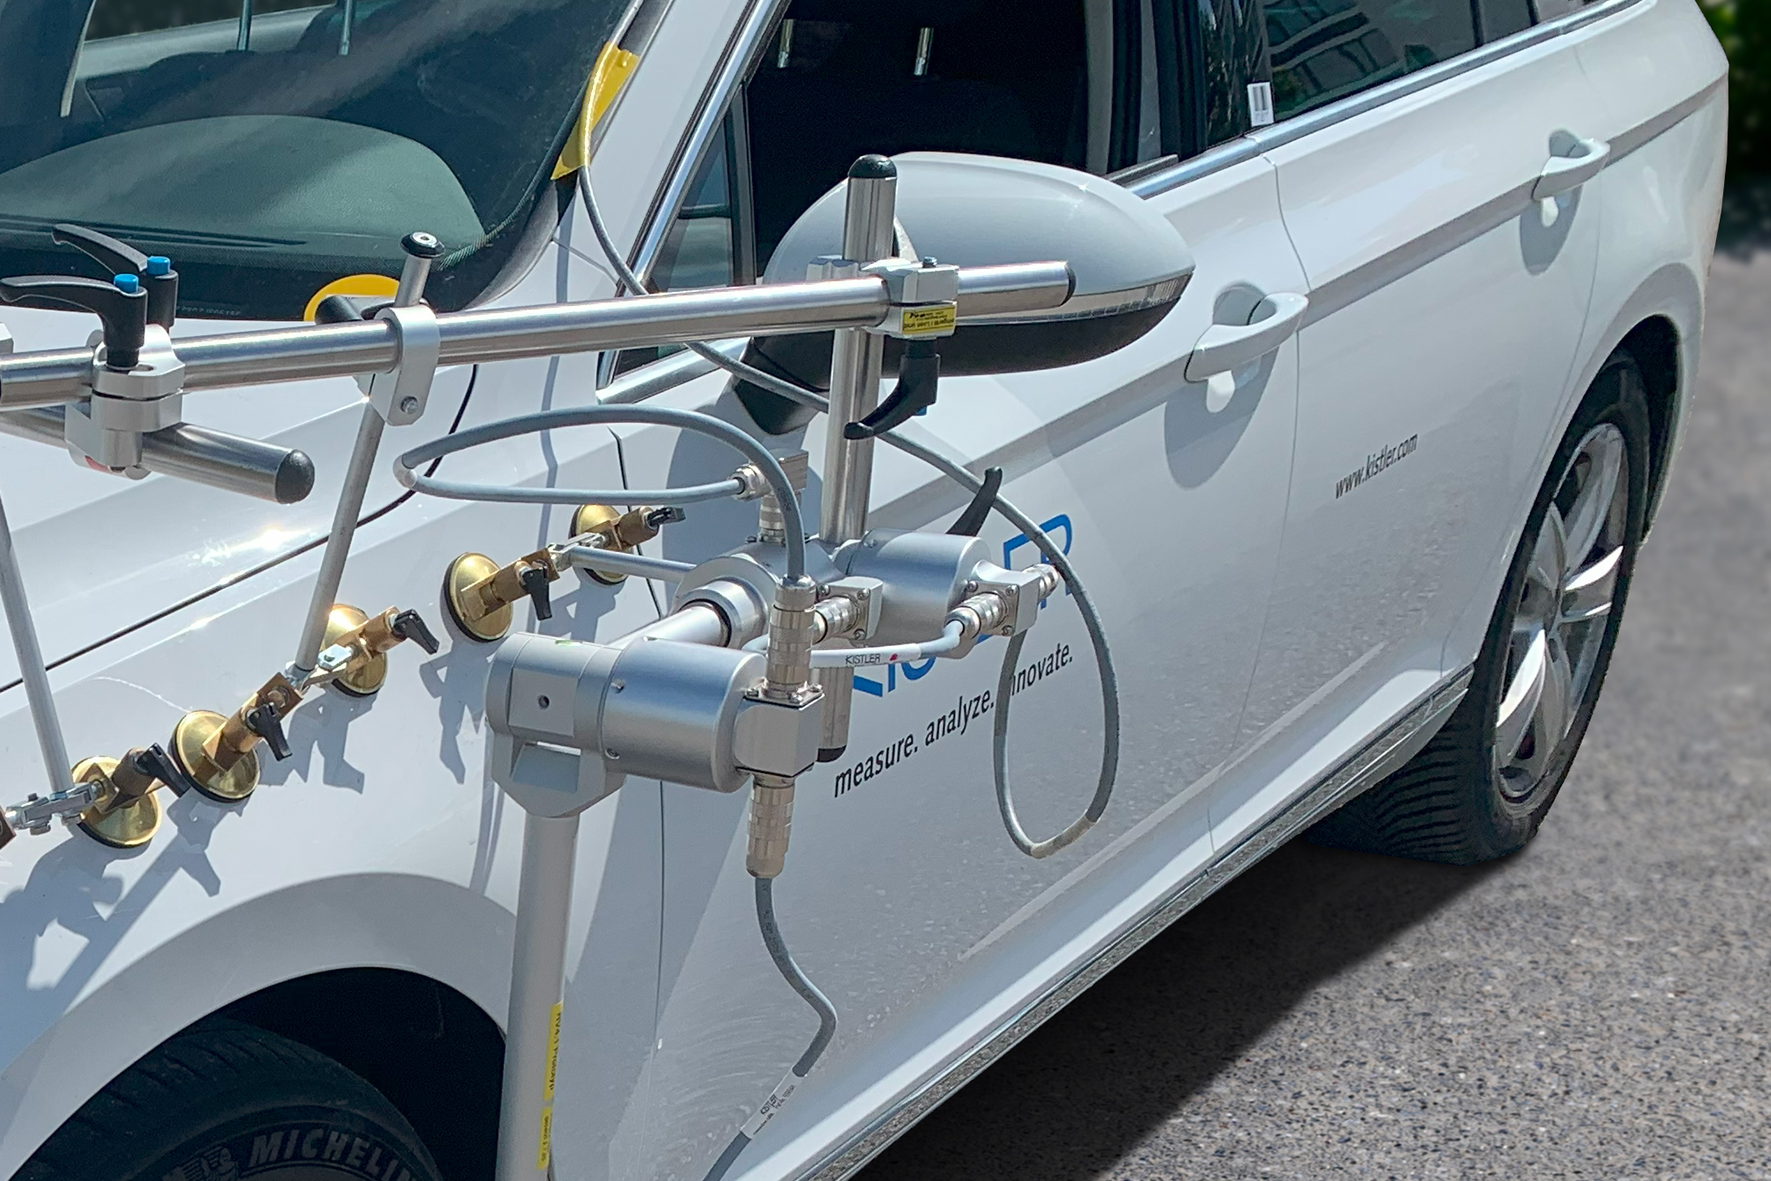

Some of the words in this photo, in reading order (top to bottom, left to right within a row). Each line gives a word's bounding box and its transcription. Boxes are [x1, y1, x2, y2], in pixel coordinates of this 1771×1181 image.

[1335, 433, 1418, 500] www.kistler.com
[845, 653, 881, 666] KISTLER
[834, 735, 919, 798] measure.
[925, 687, 994, 747] analyze.
